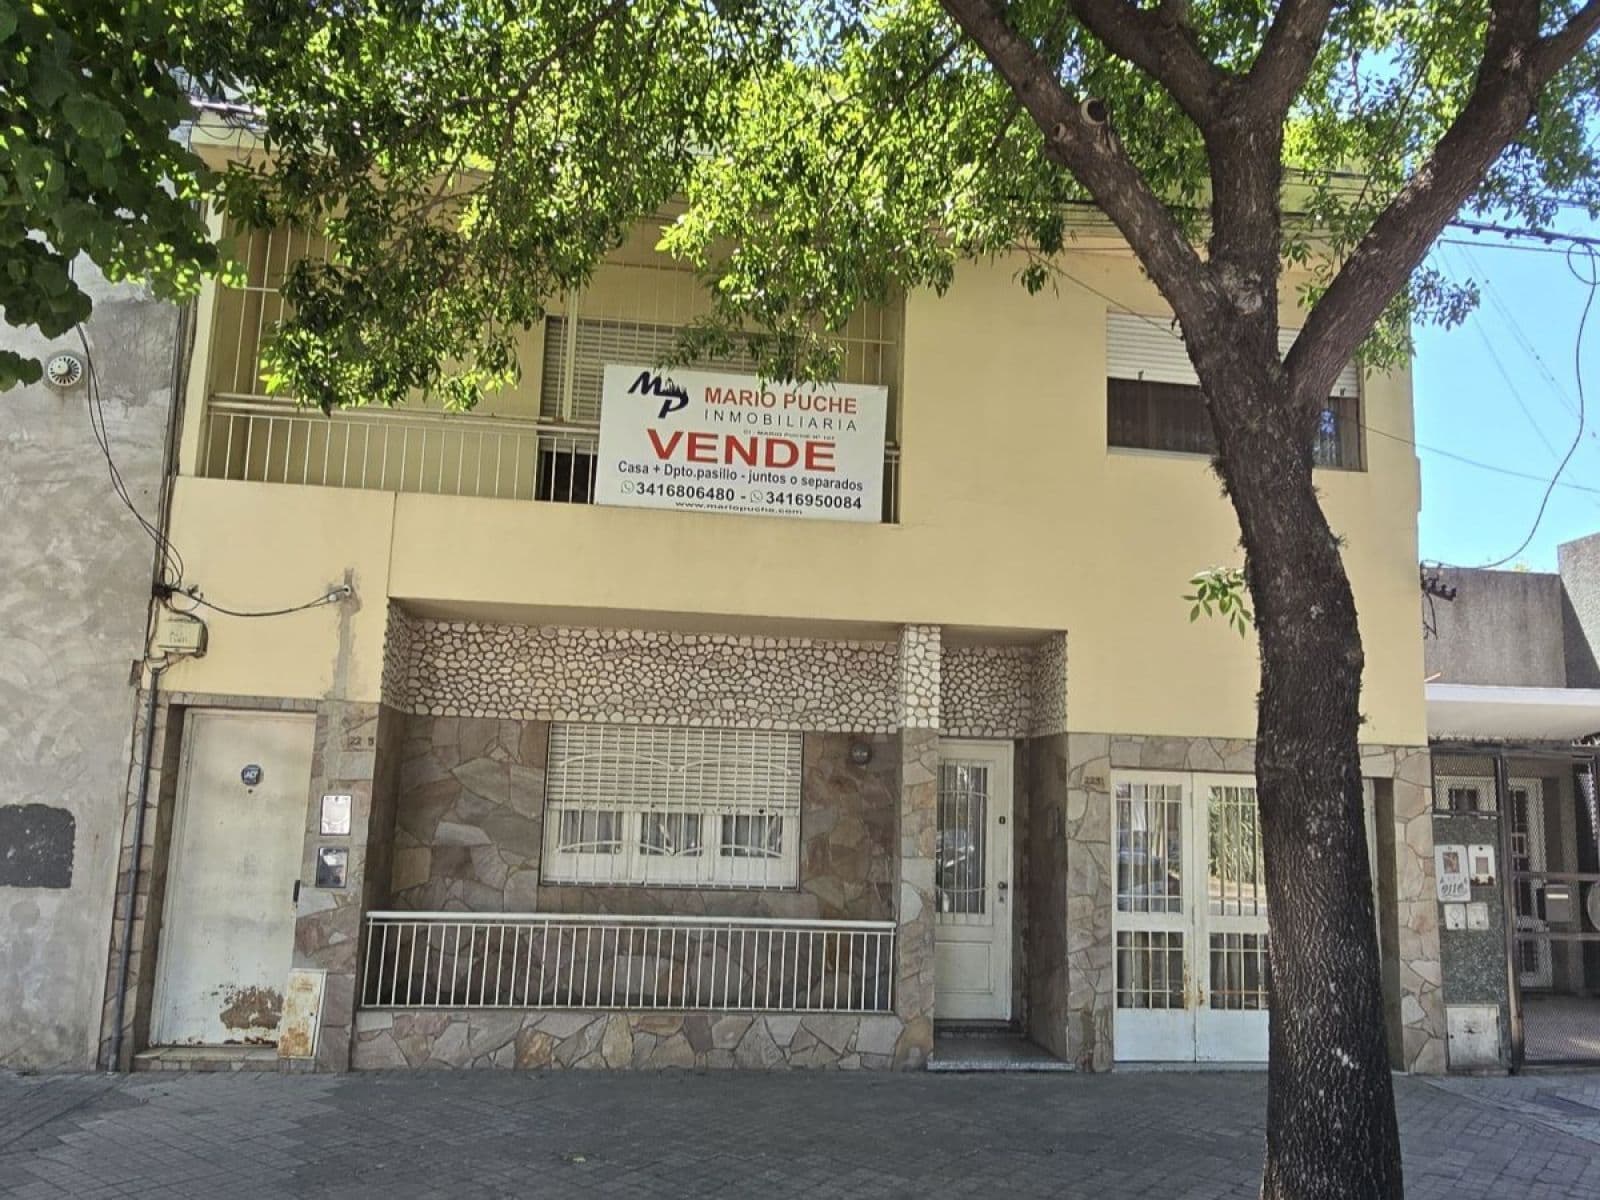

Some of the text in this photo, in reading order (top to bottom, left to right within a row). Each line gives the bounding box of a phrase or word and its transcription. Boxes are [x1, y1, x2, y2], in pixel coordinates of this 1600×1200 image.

[704, 387, 857, 414] MARIO PUCHE
[704, 409, 857, 431] INMOBILIARIA
[647, 428, 836, 472] VENDE
[618, 460, 649, 474] Casa
[653, 464, 660, 473] +
[664, 463, 737, 480] Dpto.pasillo
[748, 470, 786, 484] juntos
[790, 475, 797, 485] o
[801, 476, 863, 491] separados
[636, 481, 735, 501] 3416806480
[766, 491, 862, 509] 3416950084
